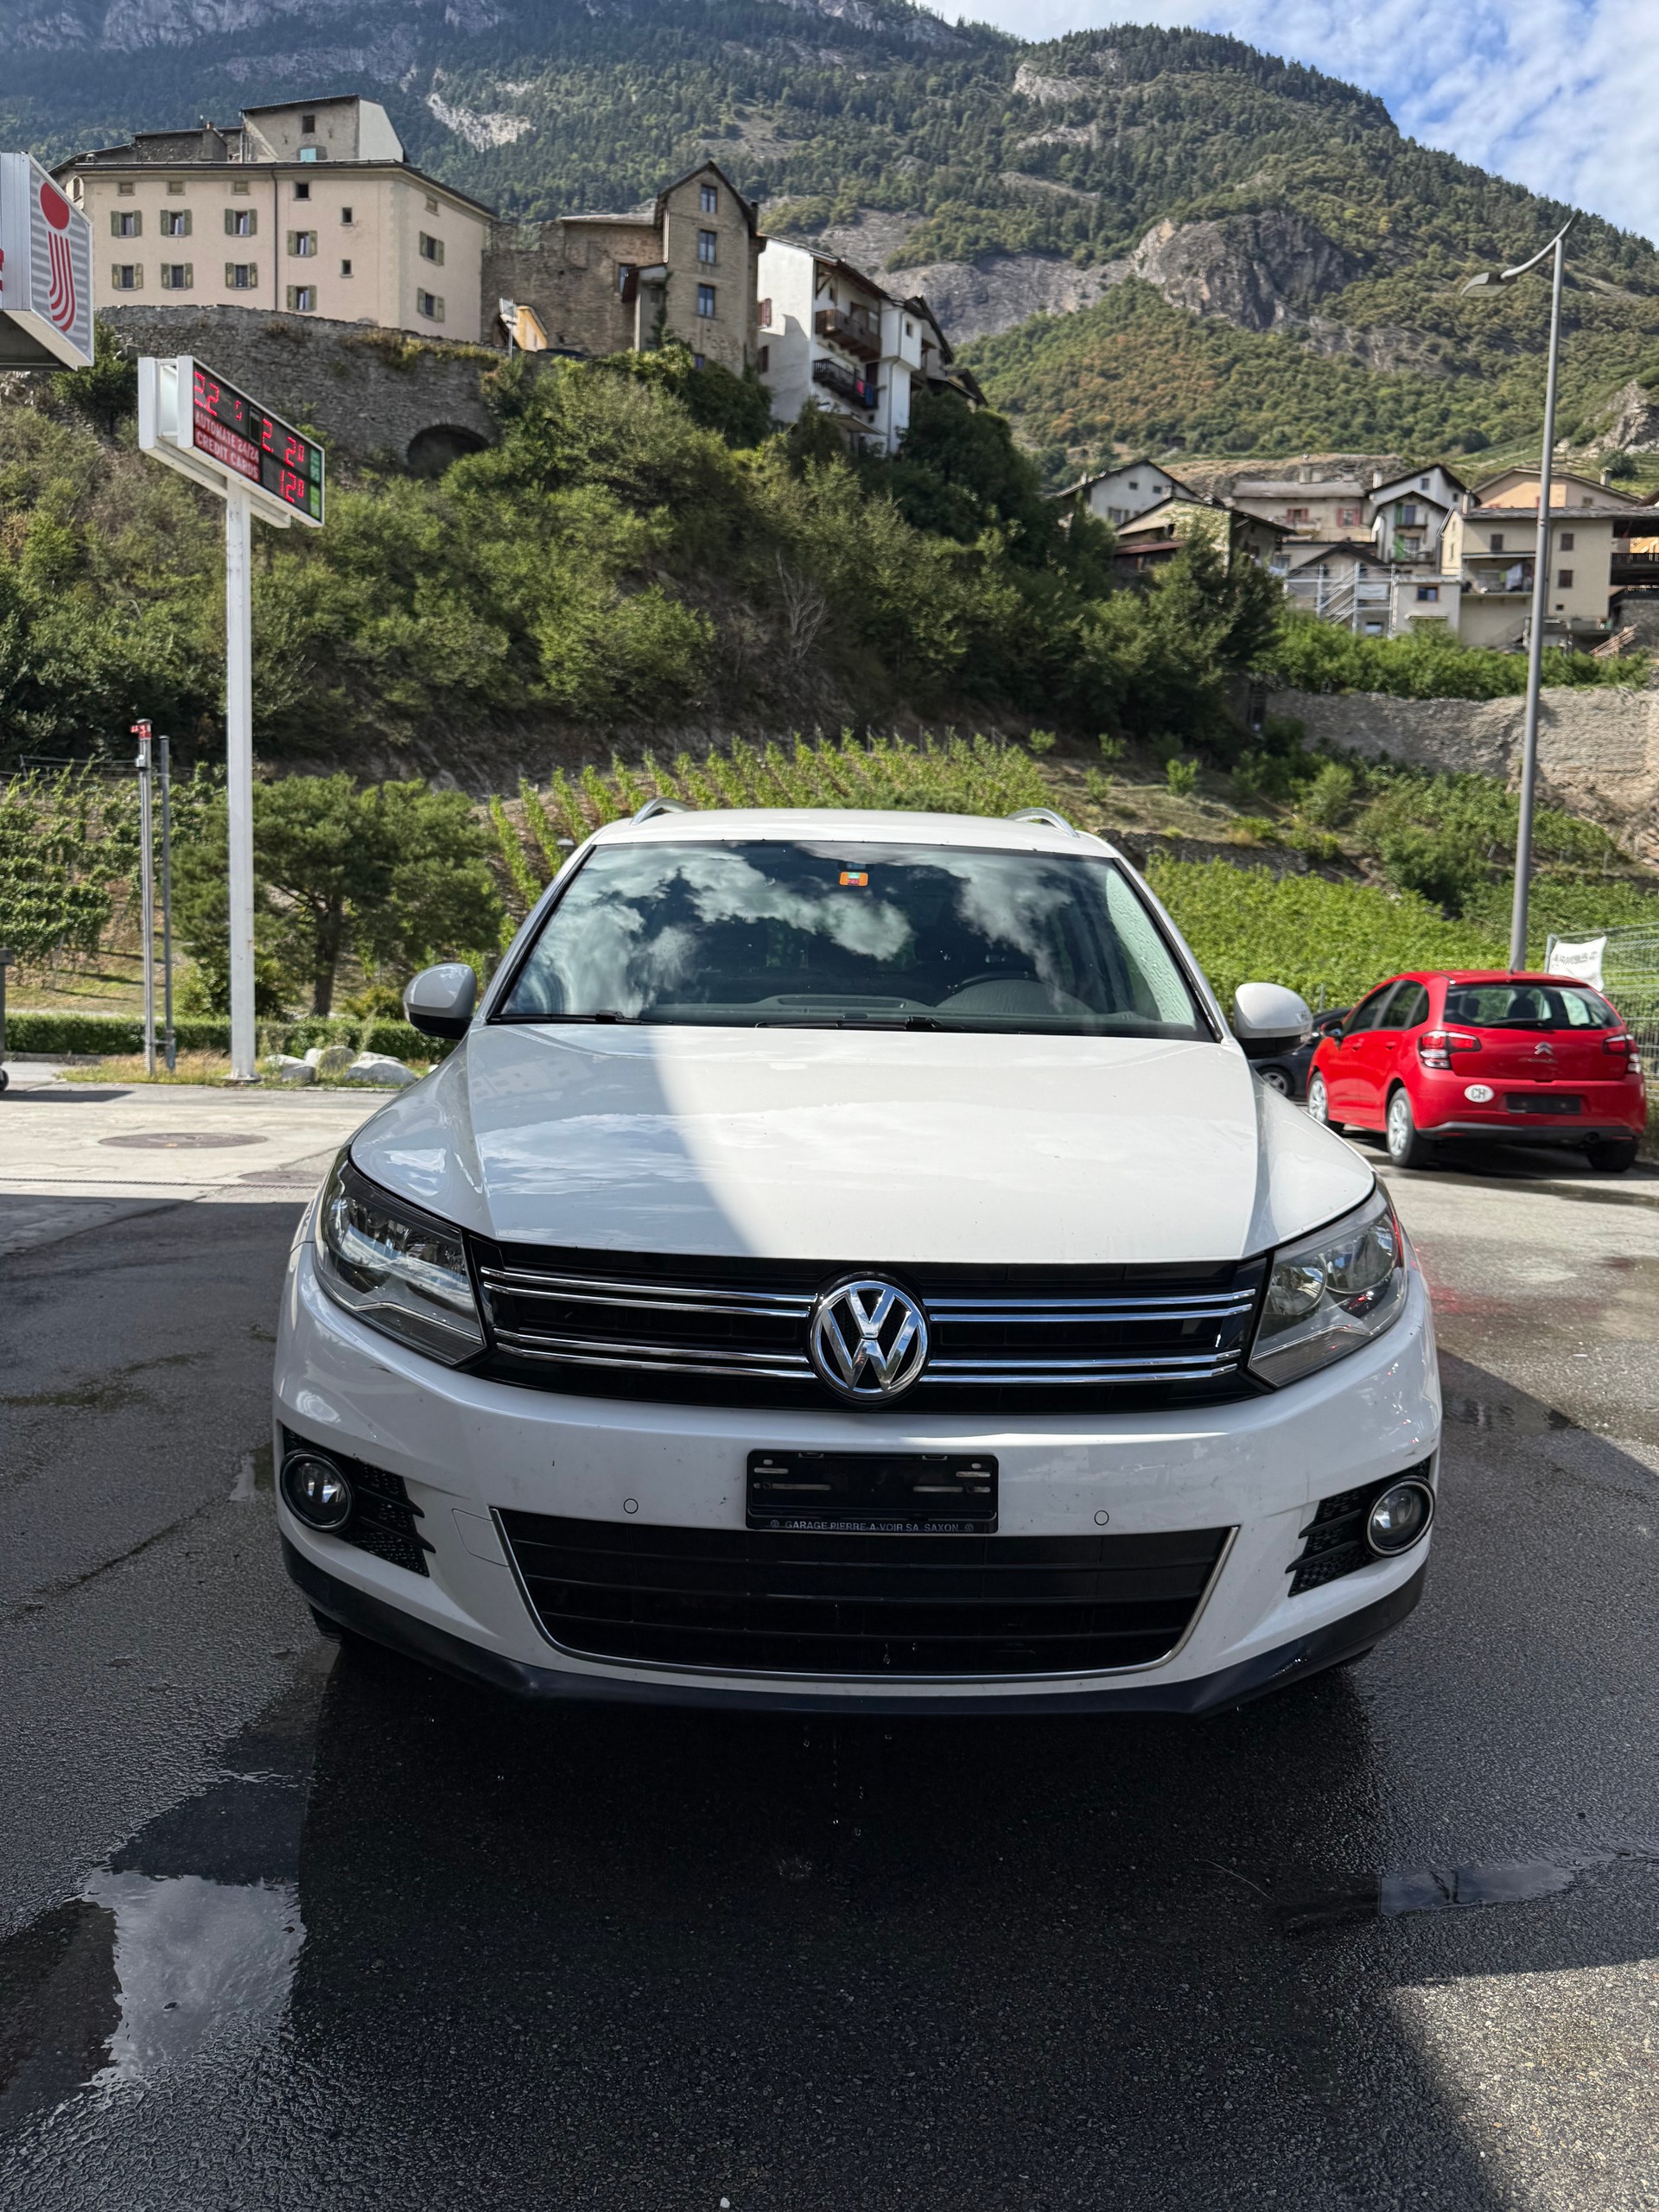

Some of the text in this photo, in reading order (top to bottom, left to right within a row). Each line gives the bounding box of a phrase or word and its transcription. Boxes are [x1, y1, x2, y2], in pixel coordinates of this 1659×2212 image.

[194, 410, 237, 449] AUTOMATE
[238, 438, 259, 464] 24/24
[196, 429, 259, 480] CREDIT CARDS
[785, 1521, 828, 1530] GARAGE
[925, 1523, 959, 1533] SAXON
